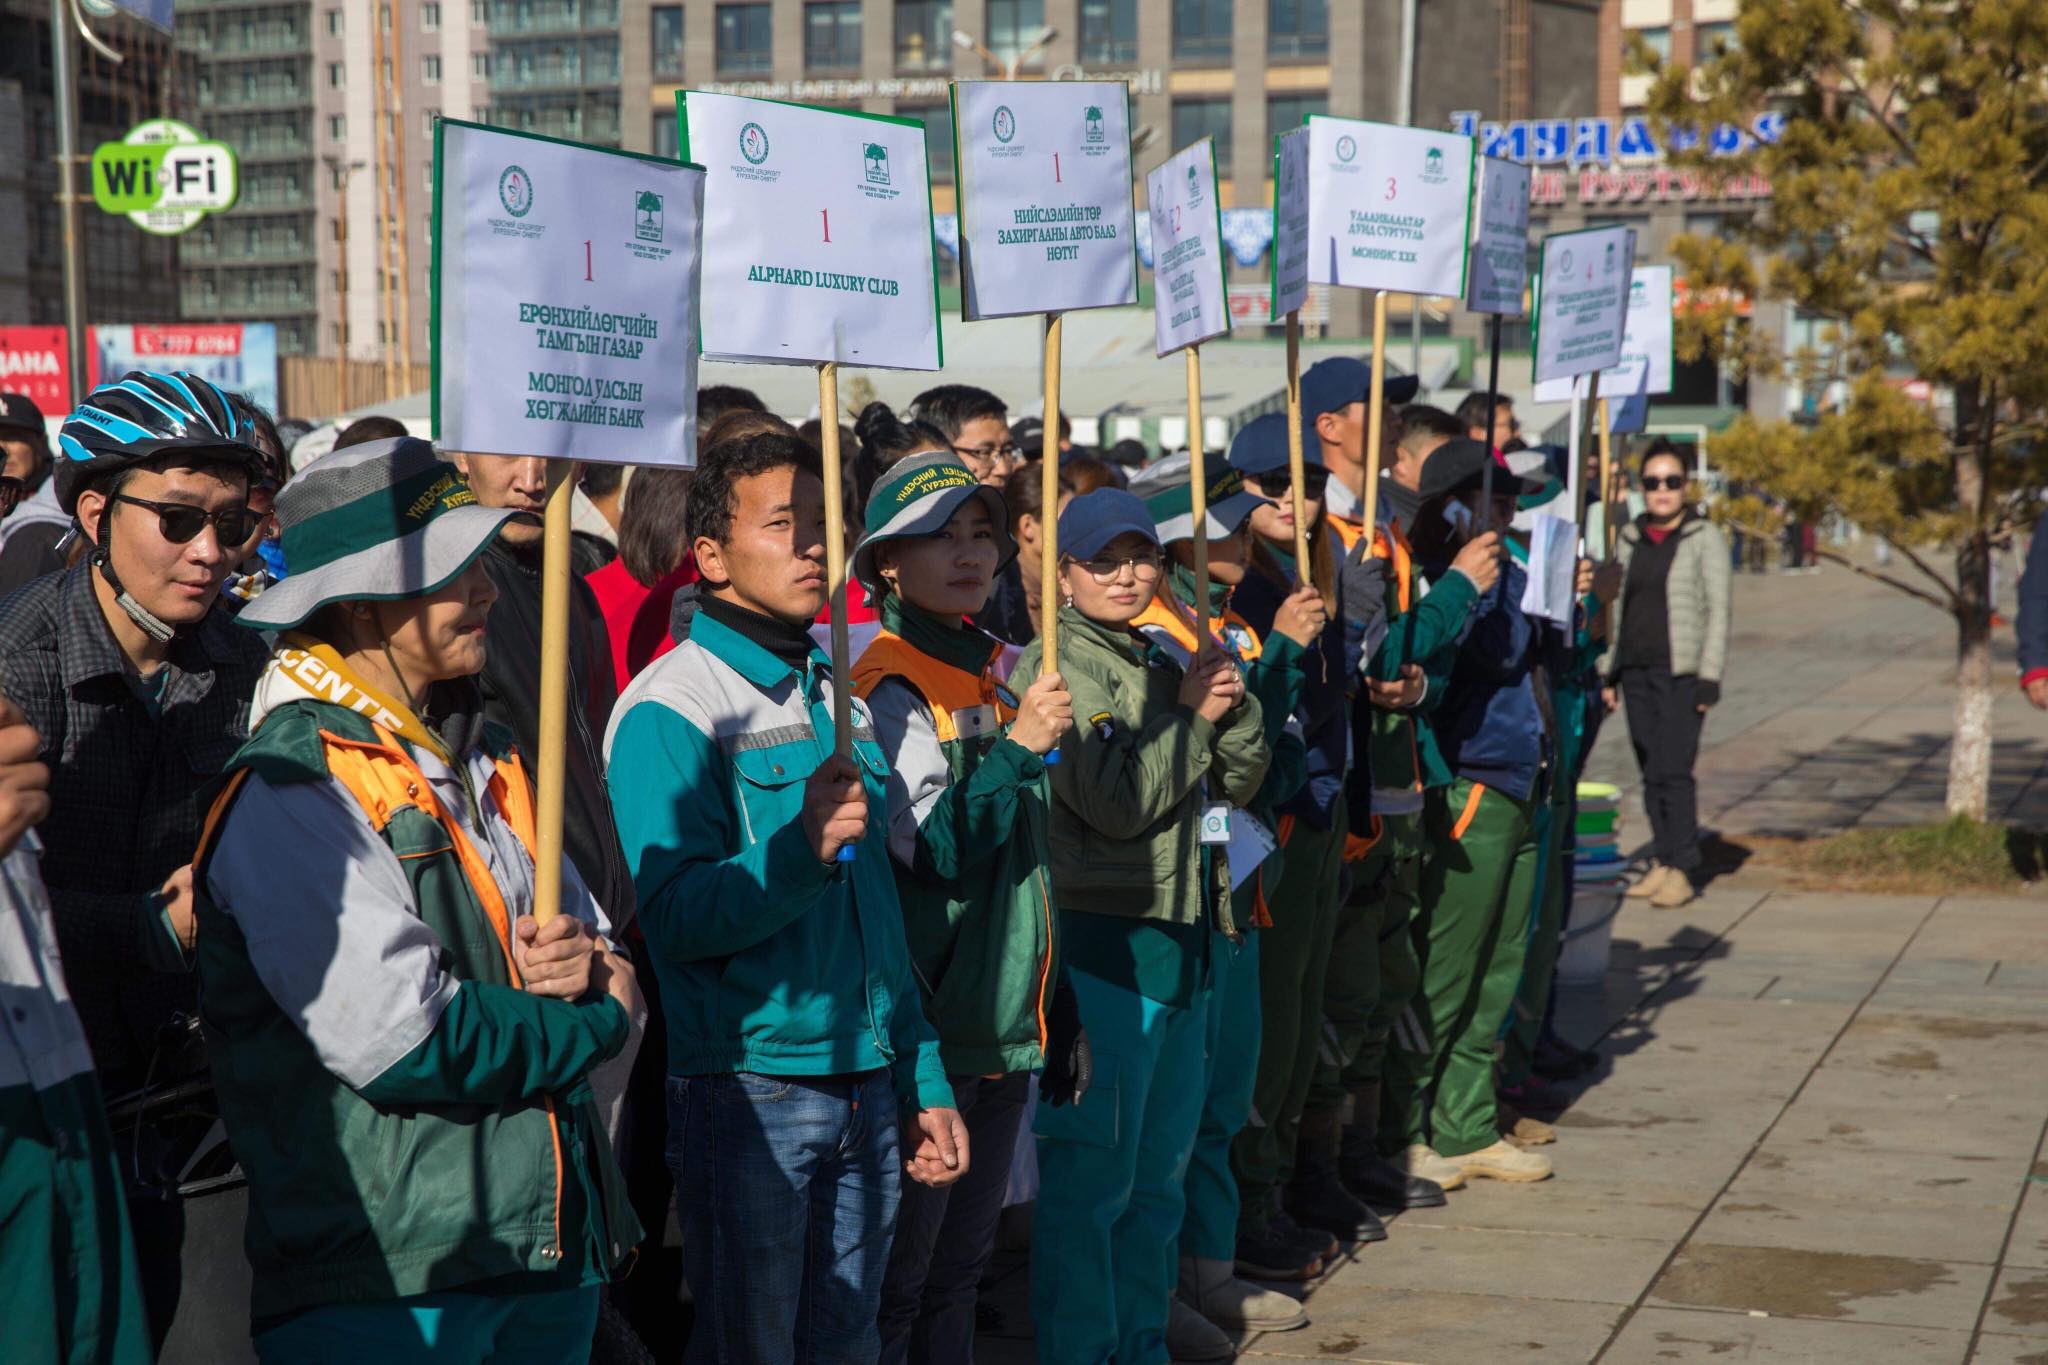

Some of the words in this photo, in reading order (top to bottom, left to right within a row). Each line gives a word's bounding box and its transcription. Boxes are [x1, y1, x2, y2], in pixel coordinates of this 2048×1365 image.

[1054, 152, 1062, 182] 1
[1385, 176, 1397, 201] 3
[820, 208, 832, 243] 1
[1014, 203, 1084, 224] НИЙСЛЭЛИЙН
[1084, 206, 1101, 221] ТӨР
[998, 228, 1069, 245] ЗАХИРГААНЫ
[1069, 226, 1092, 241] АВТО
[1094, 224, 1116, 239] БААЗ
[584, 240, 594, 281] 1
[748, 265, 813, 287] ALPHARD
[816, 271, 866, 293] LUXURY
[868, 277, 898, 296] CLUB
[519, 303, 658, 339] ЕРӨНХИЙЛӨГЧИЙН
[536, 328, 600, 355] ТАМГЫН
[602, 336, 644, 360] ГАЗАР
[528, 372, 592, 397] МОНГОЛ
[594, 378, 644, 403] УЛСЫН
[82, 407, 113, 426] GIANT
[525, 399, 607, 426] ХӨГЖЛИЙН
[609, 406, 645, 429] БАНК
[896, 467, 937, 502] ҮНДЭСНИЙ
[920, 477, 966, 494] ХҮРЭЭЛЭН
